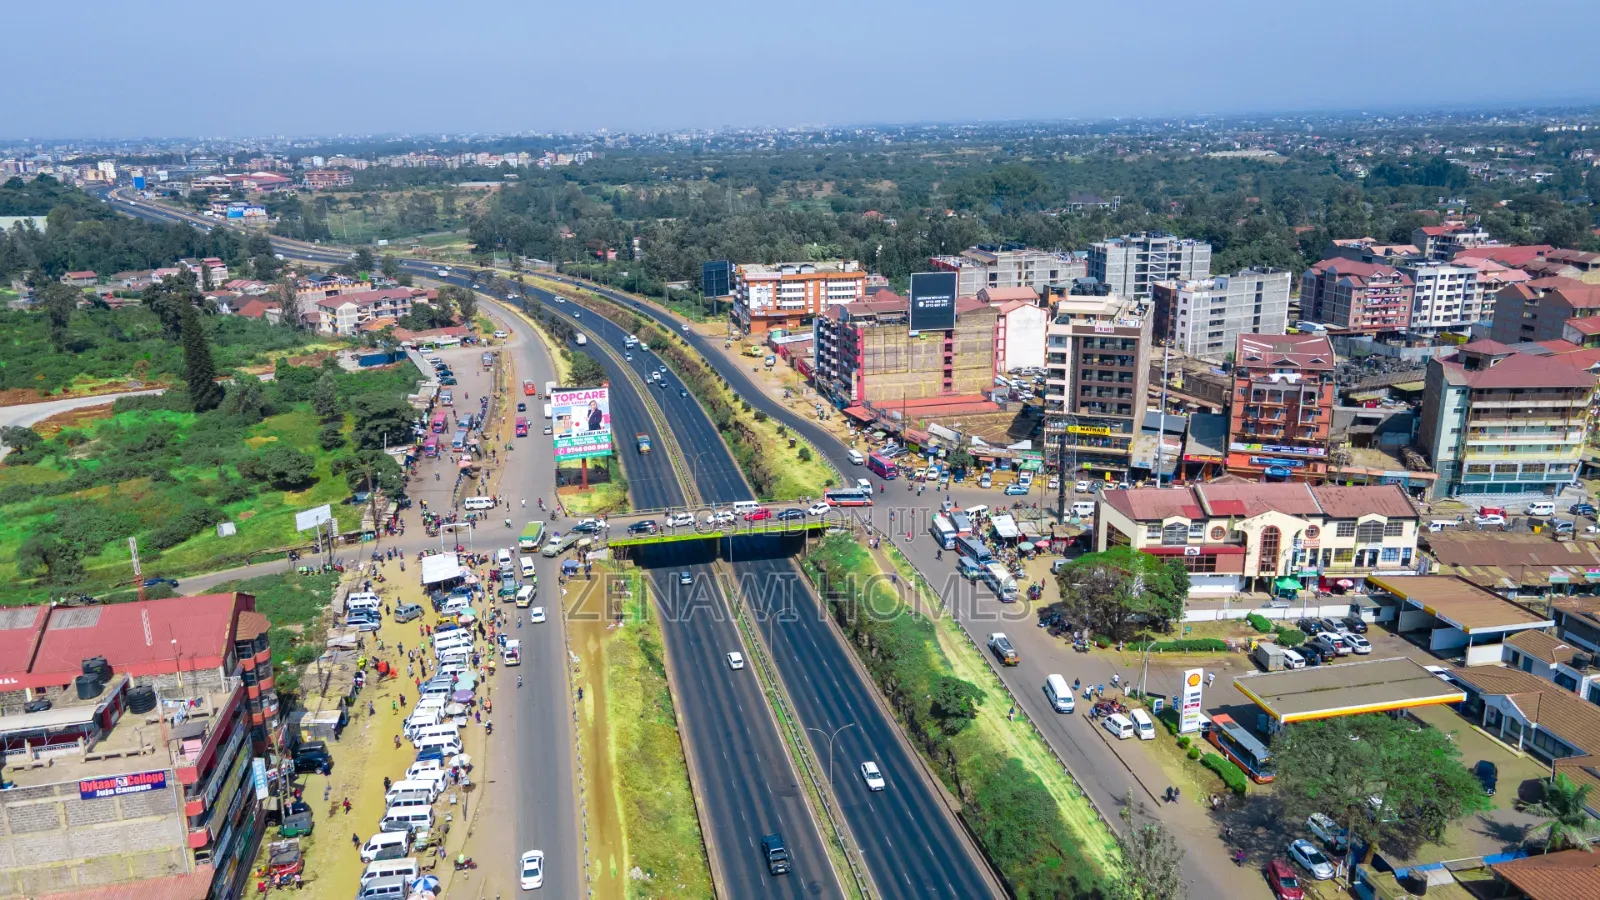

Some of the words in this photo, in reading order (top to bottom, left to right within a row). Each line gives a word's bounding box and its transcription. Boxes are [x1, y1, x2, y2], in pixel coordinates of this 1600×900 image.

[554, 390, 606, 402] TOPCARE
[80, 779, 117, 792] Dykaan
[127, 772, 164, 786] College
[96, 788, 115, 797] Juja
[115, 783, 152, 794] Campus
